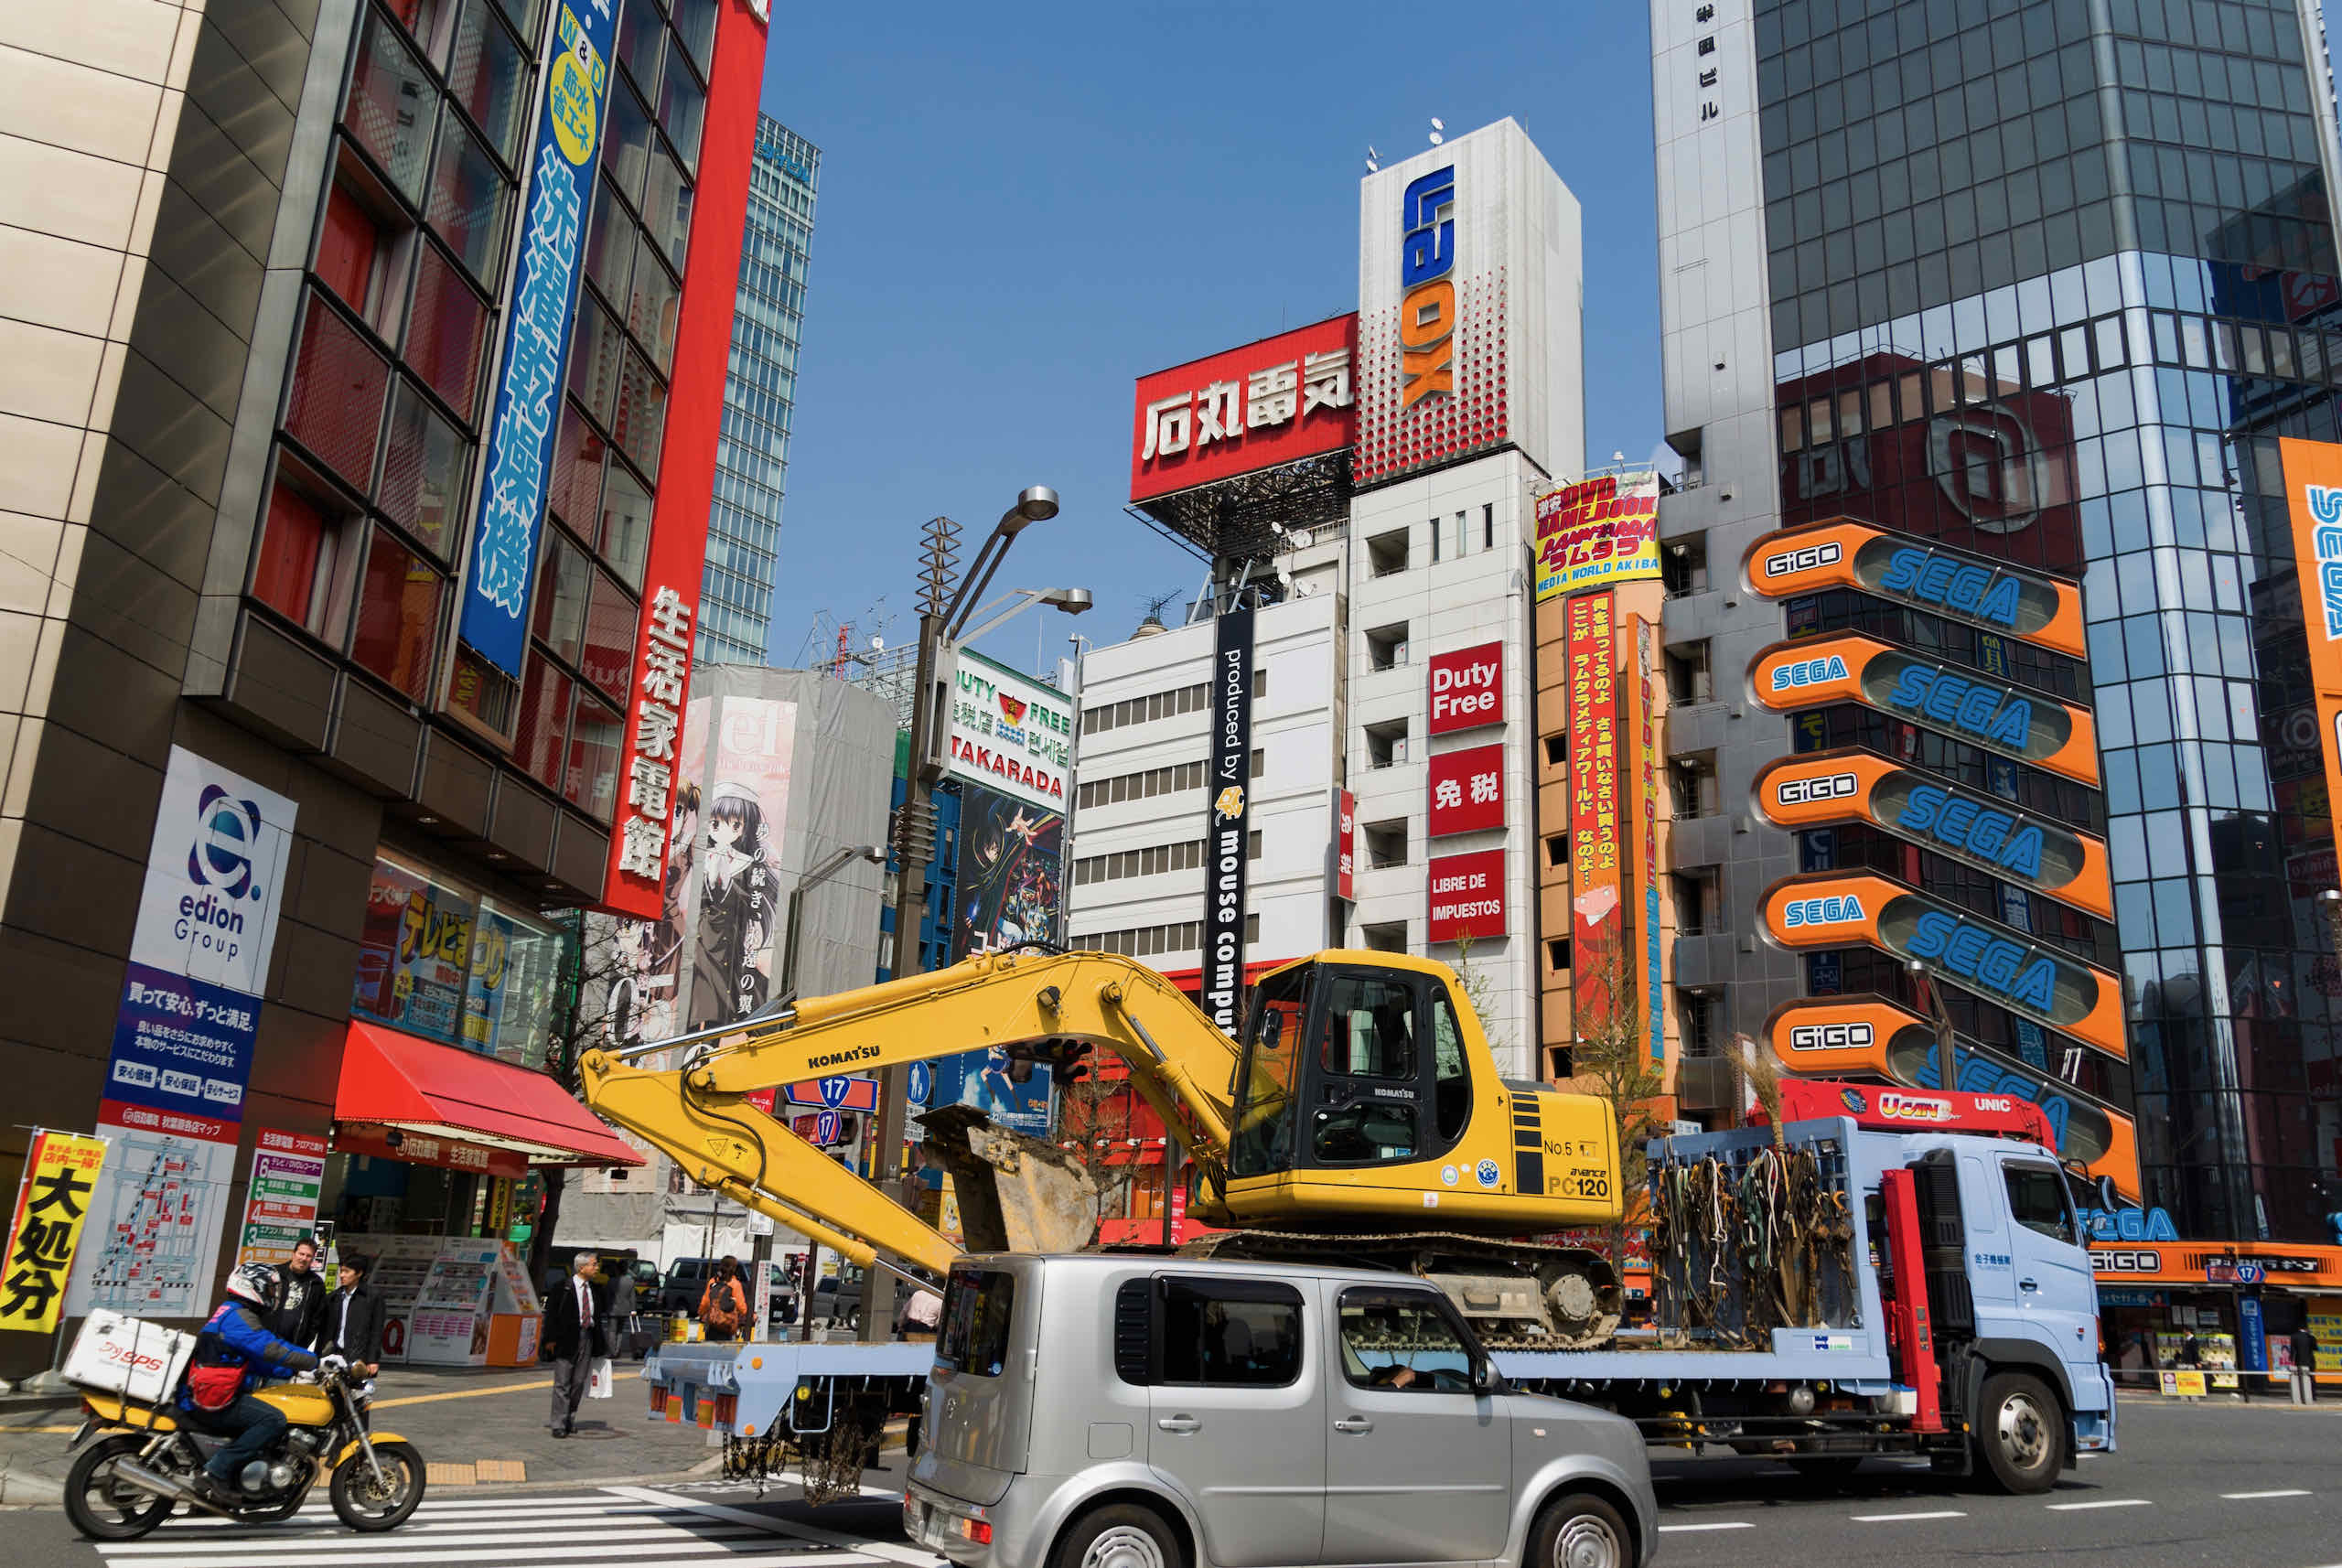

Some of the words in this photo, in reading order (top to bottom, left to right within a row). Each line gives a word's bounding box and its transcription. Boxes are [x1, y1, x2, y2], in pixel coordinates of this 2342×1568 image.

[478, 144, 580, 618] 洗濯乾燥機
[1142, 348, 1354, 460] 石丸電気
[1561, 478, 1617, 510] DVD
[1537, 504, 1591, 540] GAME
[1595, 496, 1657, 521] BOOK
[1550, 537, 1639, 573] ラムタラ
[1765, 542, 1842, 577] GiGO
[1538, 571, 1569, 593] MEDIA
[1572, 562, 1612, 580] WORLD
[1616, 558, 1659, 572] AKIBA
[1879, 548, 2020, 625] SEGA
[1573, 602, 1590, 641] ここが
[1434, 662, 1498, 693] Duty
[1772, 654, 1850, 692] SEGA
[1225, 649, 1243, 748] produced
[1434, 690, 1495, 720] Free
[1888, 664, 2033, 751] SEGA
[618, 585, 692, 882] 生活家電館
[1030, 702, 1070, 735] FREE
[1574, 654, 1594, 816] ラムタラメディアワールド
[951, 735, 1063, 799] TAKARADA
[1220, 754, 1241, 779] by
[1435, 772, 1499, 810] 免税
[1777, 772, 1858, 806] GiGO
[1896, 784, 2045, 881] SEGA
[1218, 830, 1240, 923] mouse
[1433, 875, 1466, 894] LIBRE
[1468, 873, 1487, 890] DE
[179, 893, 243, 934] edion
[1433, 899, 1500, 921] IMPUESTOS
[1785, 894, 1866, 928] SEGA
[175, 918, 238, 961] Group
[1906, 910, 2057, 1013] SEGA
[1789, 1022, 1875, 1052] GiGO
[808, 1045, 881, 1069] KOMATSU
[824, 1079, 845, 1100] 17
[1374, 1087, 1415, 1099] KOMATSU
[1974, 1097, 2013, 1112] UNIC
[820, 1115, 833, 1136] 17
[259, 1158, 269, 1178] 6
[1570, 1167, 1606, 1178] avance
[255, 1180, 264, 1200] 5
[251, 1204, 261, 1224] 4
[0, 1167, 91, 1320] 大処分
[247, 1227, 257, 1247] 3
[2240, 1267, 2253, 1280] 17
